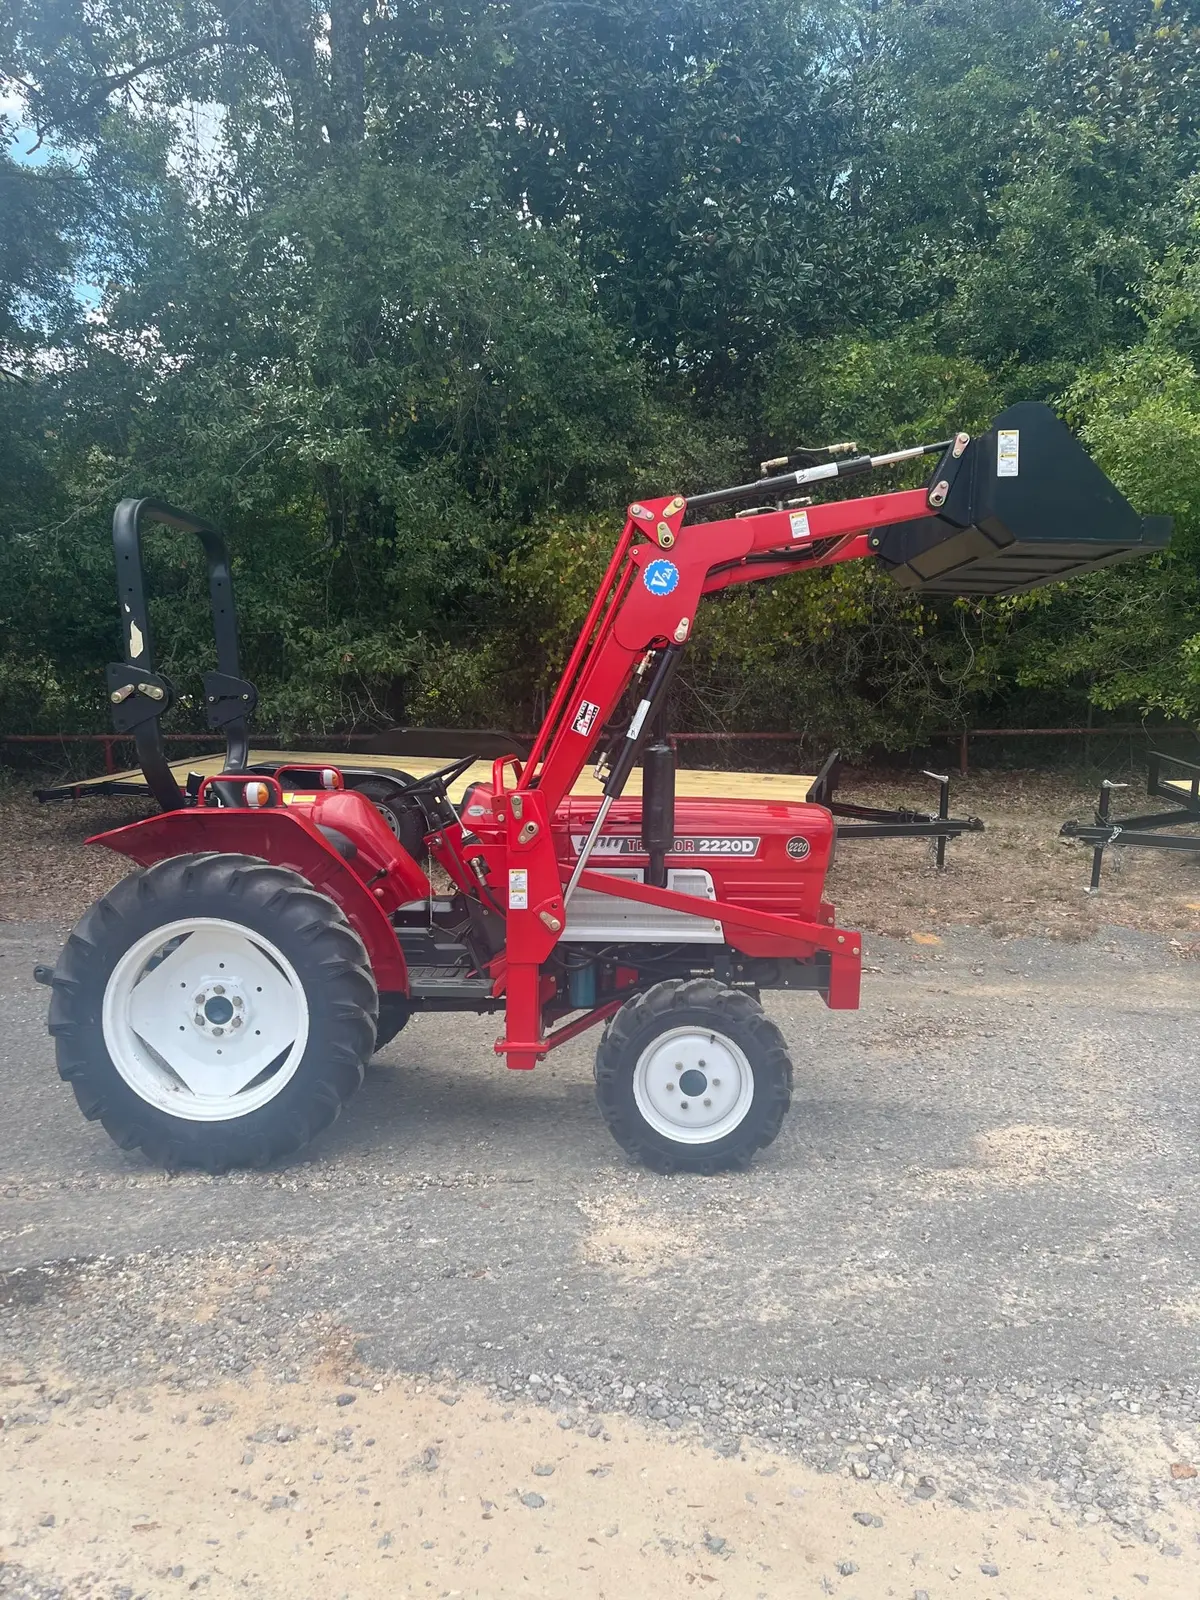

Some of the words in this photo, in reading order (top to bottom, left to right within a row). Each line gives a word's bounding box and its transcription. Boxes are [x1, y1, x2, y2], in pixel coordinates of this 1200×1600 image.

[627, 839, 695, 852] TROR
[699, 840, 754, 851] 2220D
[788, 842, 808, 852] 2220
